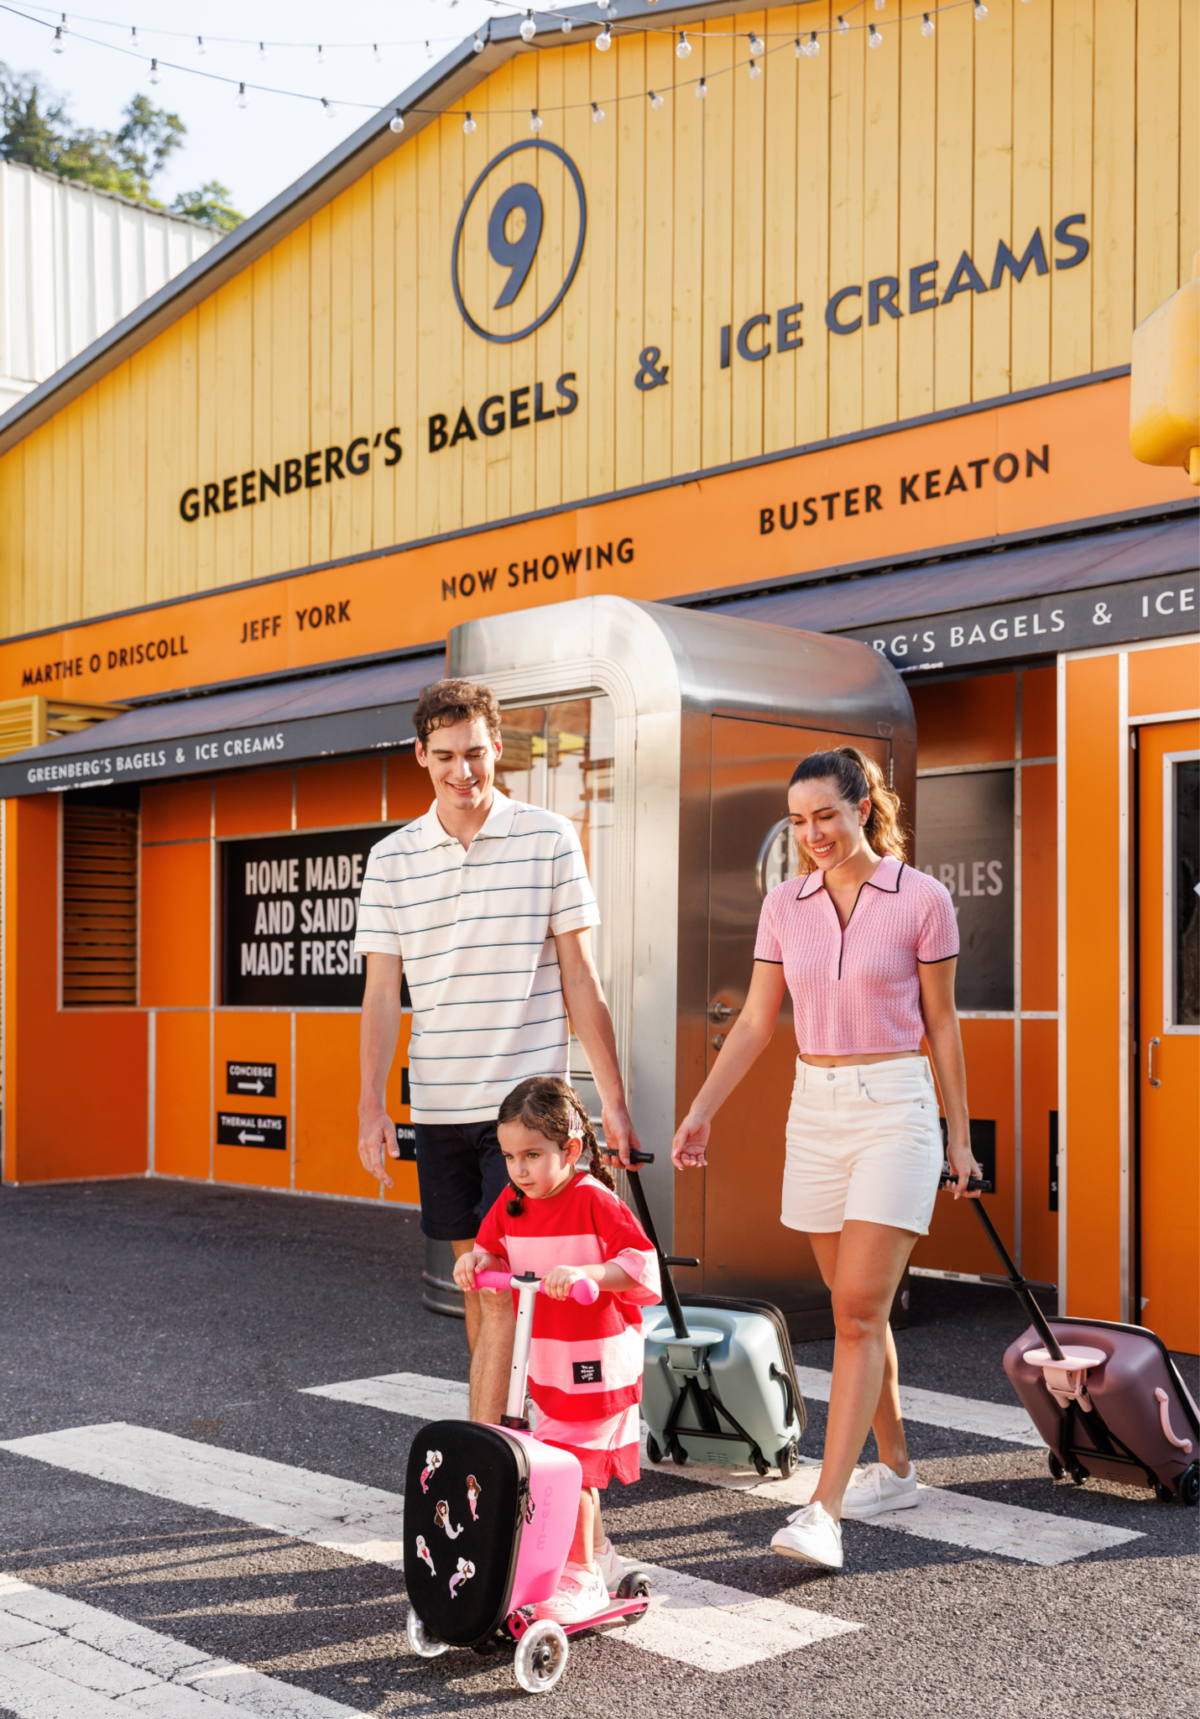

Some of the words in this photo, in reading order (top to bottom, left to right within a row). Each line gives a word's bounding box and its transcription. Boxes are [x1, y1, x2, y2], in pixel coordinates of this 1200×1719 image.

[487, 182, 544, 311] 9
[178, 427, 402, 523] GREENBERG'S
[427, 372, 578, 454] BAGELS
[634, 345, 669, 392] &
[719, 302, 804, 369] ICE
[824, 213, 1090, 336] CREAMS
[759, 484, 883, 535] BUSTER
[900, 444, 1050, 505] KEATON
[441, 567, 498, 602] NOW
[508, 537, 635, 589] SHOWING
[240, 615, 282, 645] JEFF
[296, 600, 352, 632] YORK
[864, 631, 936, 658] RG'S
[949, 609, 1066, 649] BAGELS
[1092, 602, 1113, 626] &
[1142, 587, 1195, 618] ICE
[21, 656, 83, 688] MARTHE
[89, 652, 101, 674] O
[106, 634, 189, 671] DRISCOLL
[27, 757, 112, 784] GREENBERG'S
[116, 750, 167, 772] BAGELS
[175, 747, 185, 764] &
[195, 742, 219, 761] ICE
[223, 733, 285, 757] CREAMS
[245, 858, 299, 895] HOME
[305, 853, 363, 892] MADE
[254, 900, 295, 935] AND
[241, 941, 295, 976] MADE
[301, 939, 363, 975] FRESH
[229, 1065, 273, 1078] CONCIERGE
[220, 1115, 256, 1129] THERMAL
[257, 1117, 282, 1131] BATHS
